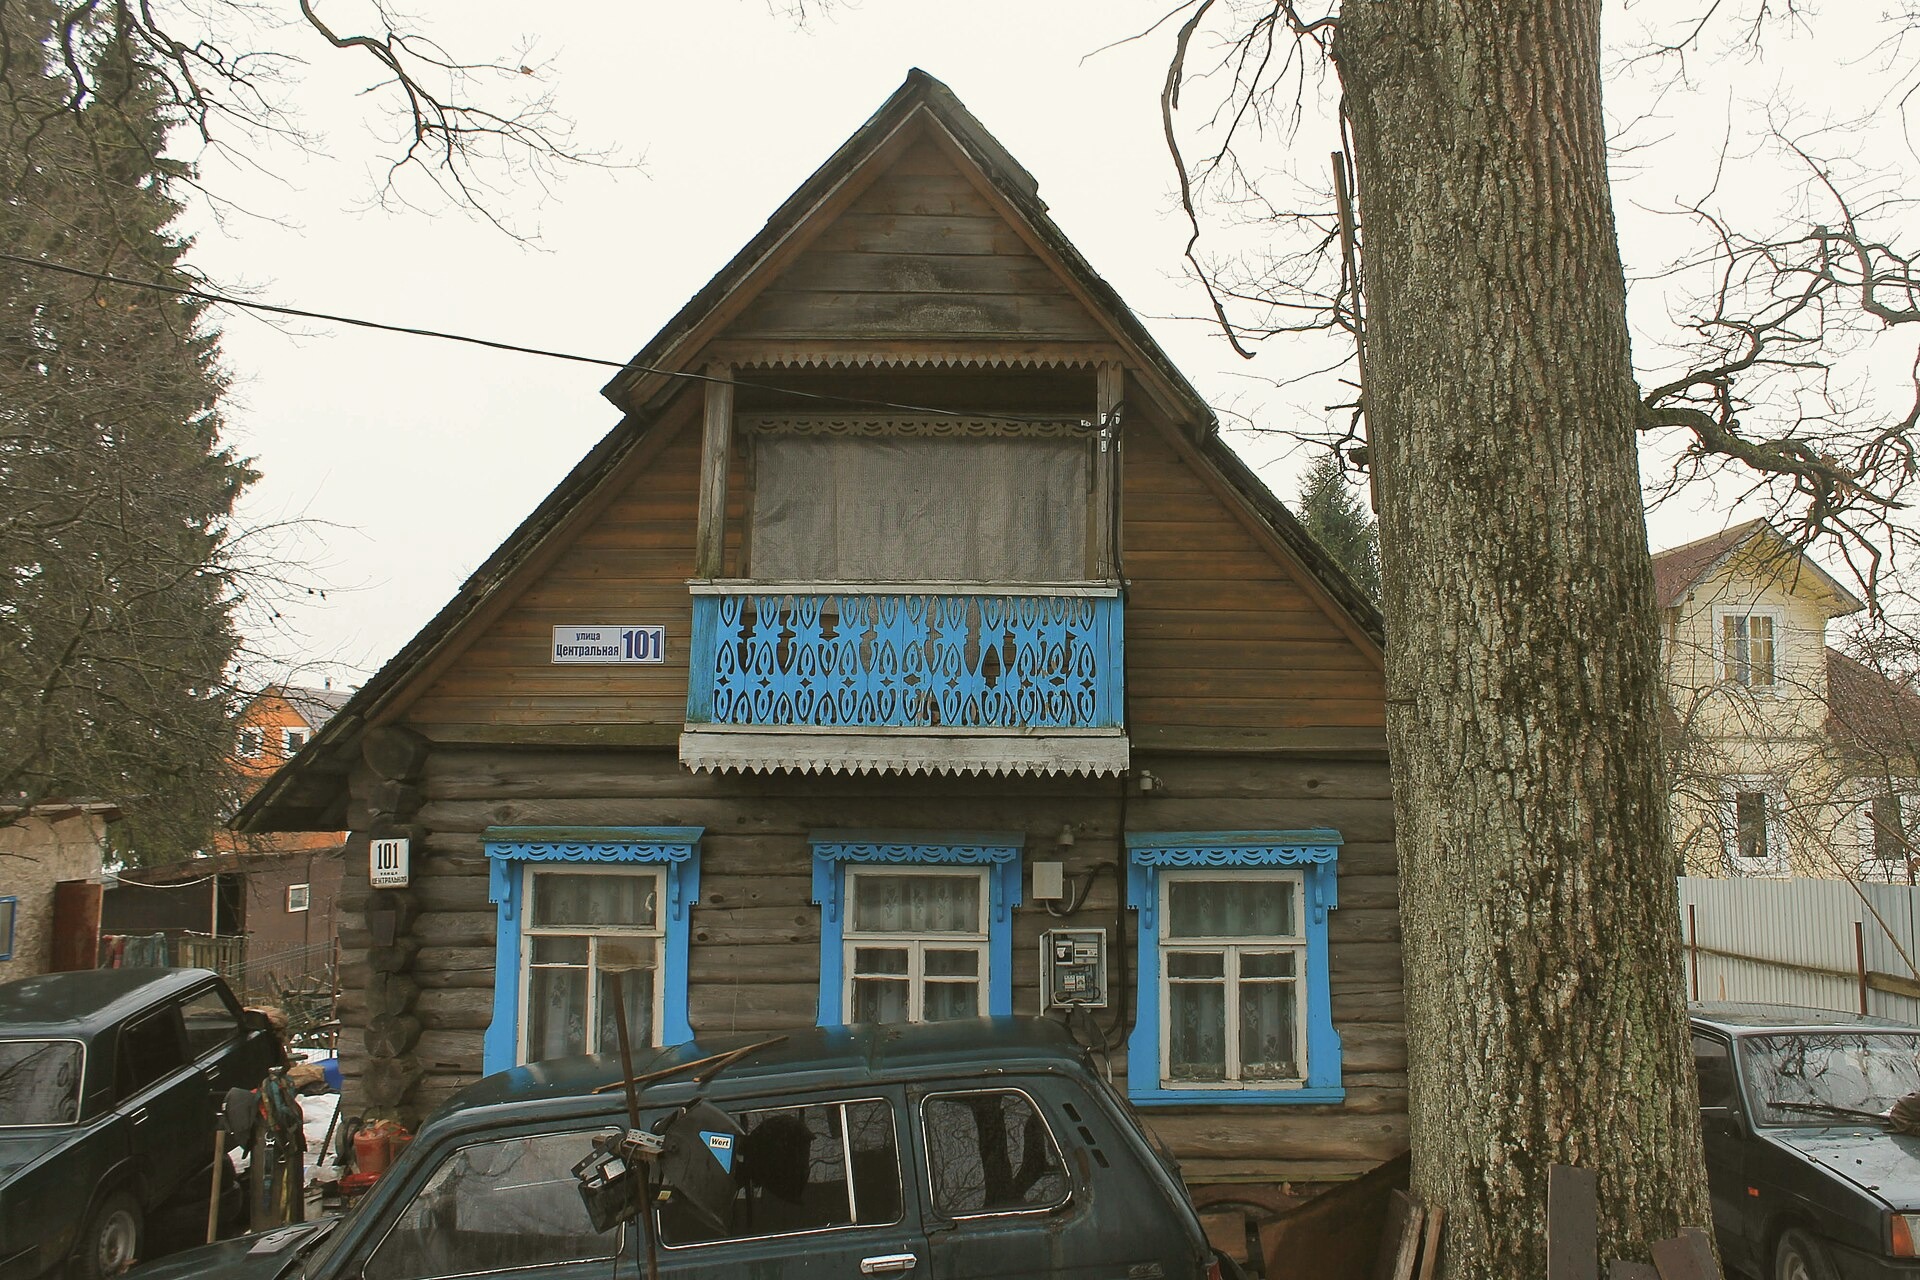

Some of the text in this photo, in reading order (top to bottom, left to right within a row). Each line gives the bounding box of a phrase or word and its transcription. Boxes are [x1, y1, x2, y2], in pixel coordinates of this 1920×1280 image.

[576, 632, 601, 641] улица
[622, 630, 661, 660] 101
[556, 644, 619, 657] Центральная
[377, 842, 399, 870] 101
